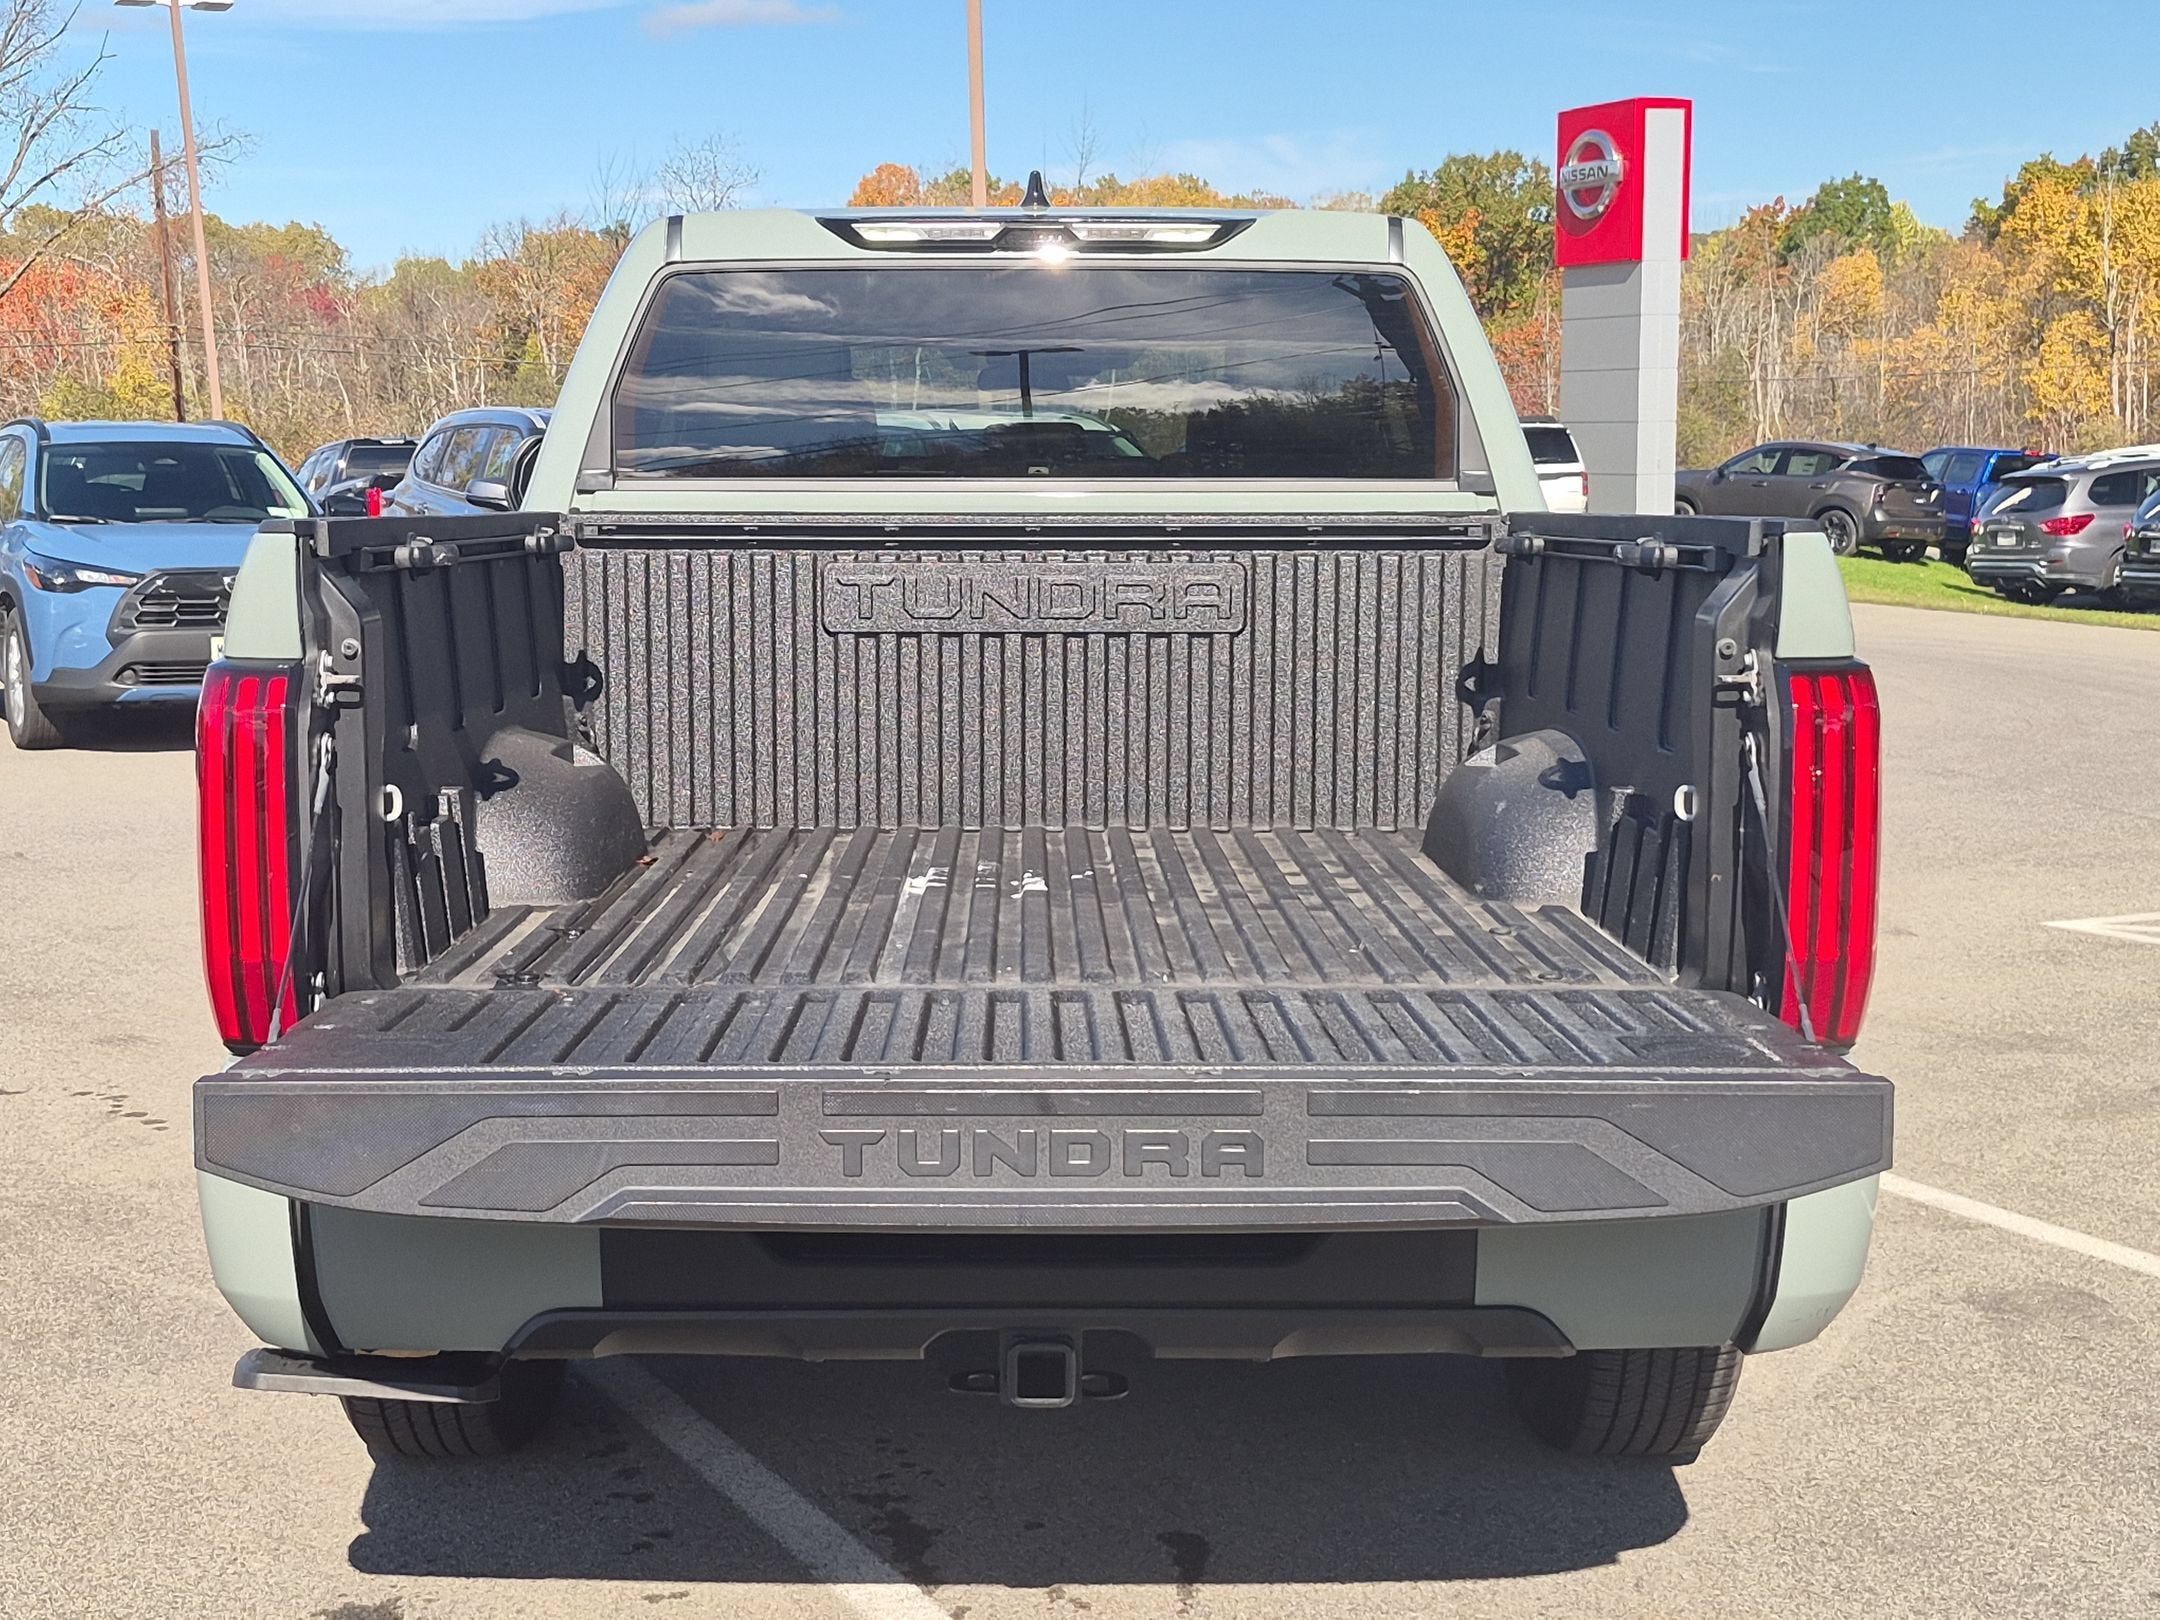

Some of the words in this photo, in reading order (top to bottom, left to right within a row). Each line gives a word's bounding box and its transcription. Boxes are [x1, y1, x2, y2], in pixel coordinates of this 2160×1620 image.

[1562, 165, 1608, 183] NISSAN
[837, 577, 1232, 619] TUNDRA
[819, 1129, 1264, 1177] TUNDRA
